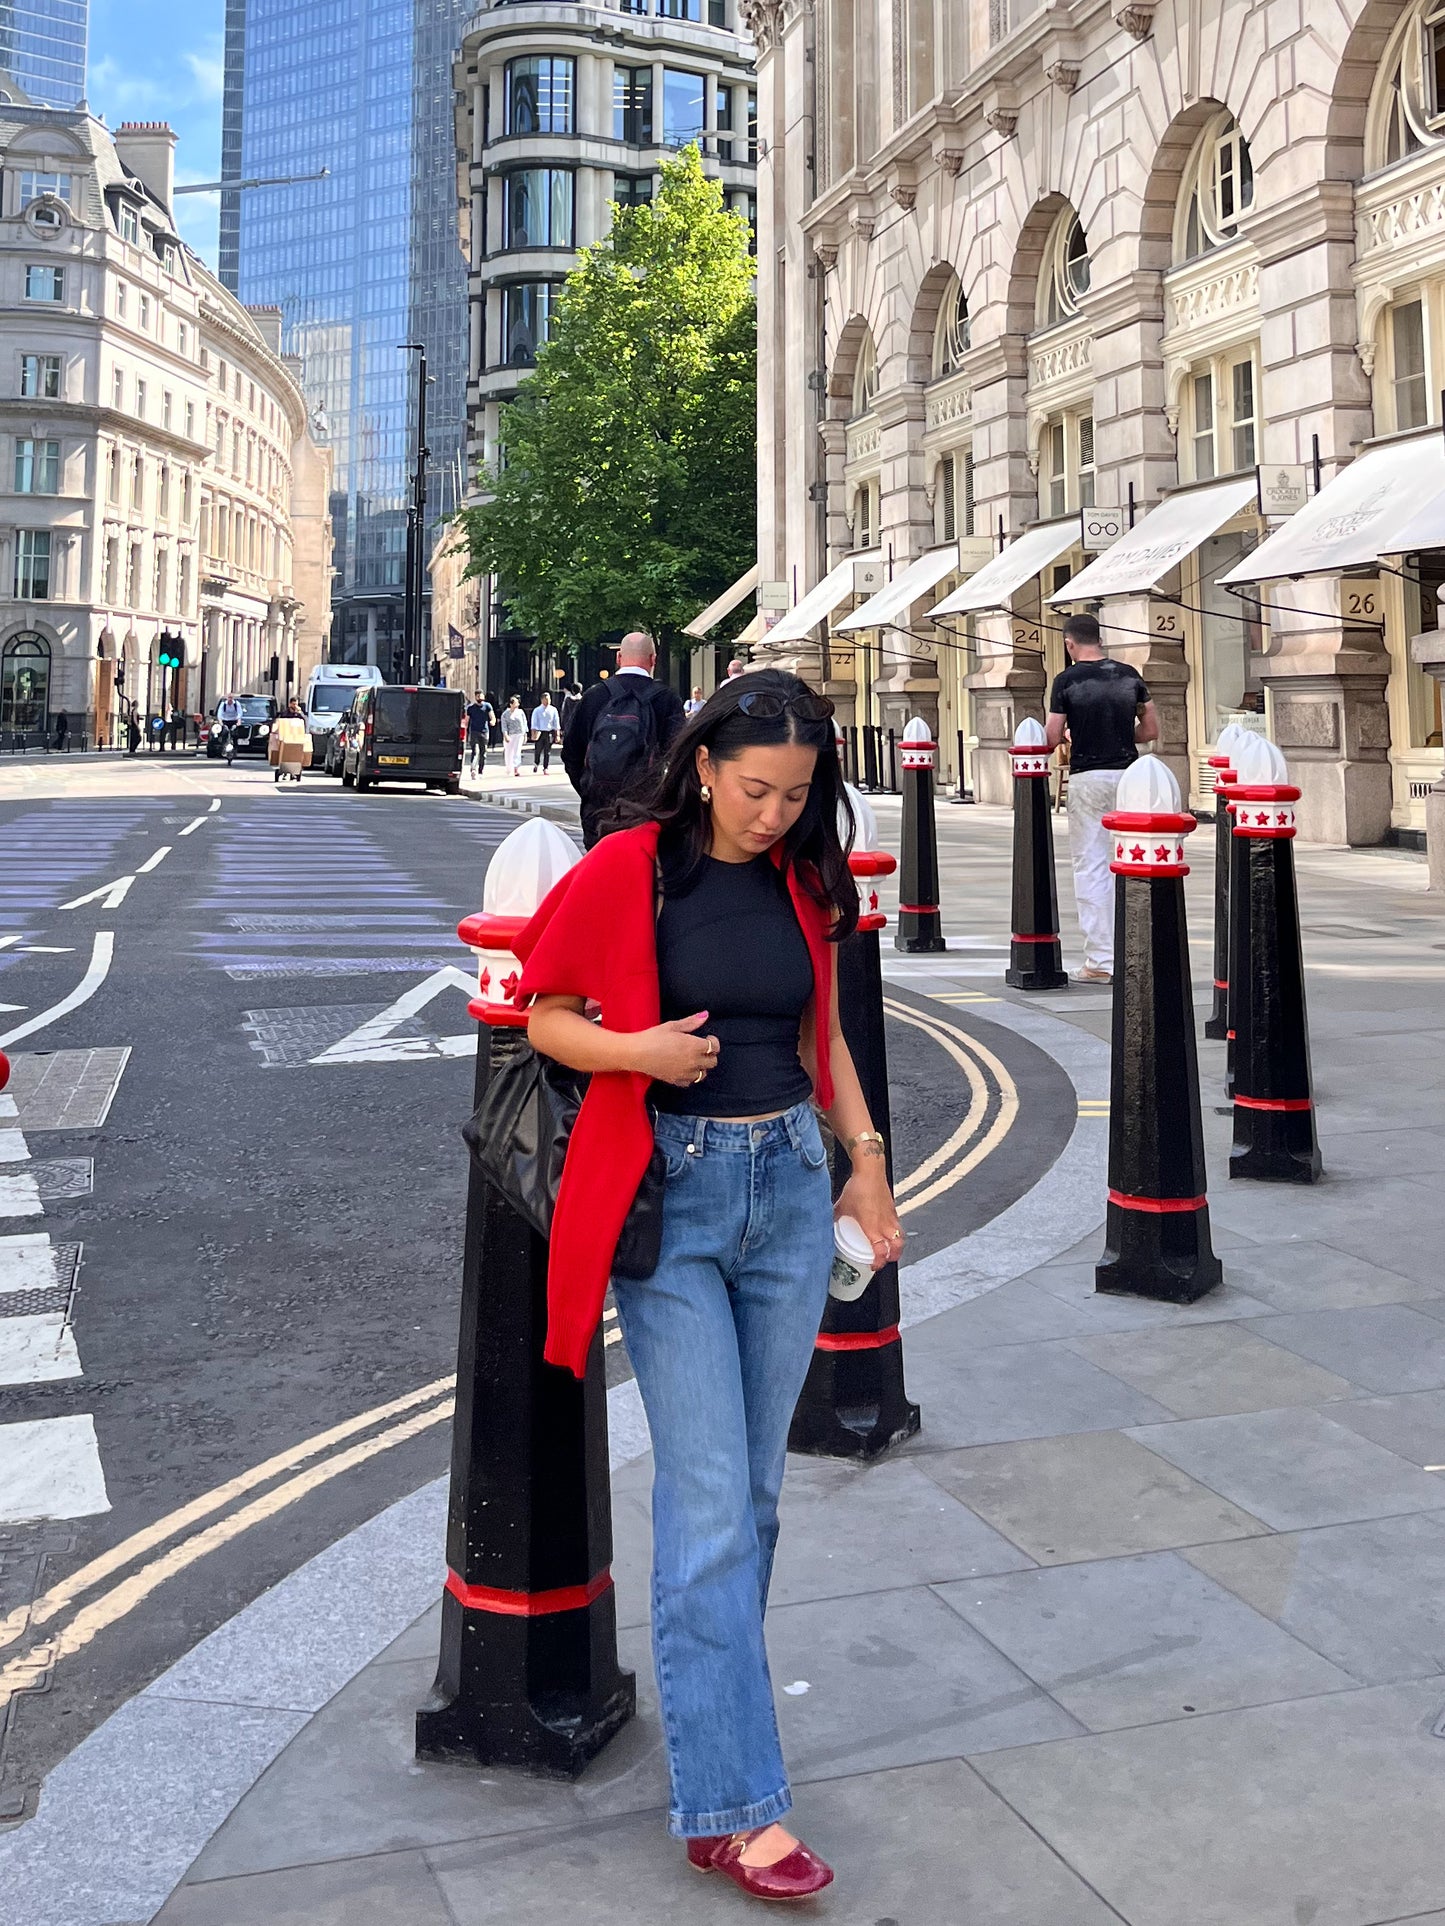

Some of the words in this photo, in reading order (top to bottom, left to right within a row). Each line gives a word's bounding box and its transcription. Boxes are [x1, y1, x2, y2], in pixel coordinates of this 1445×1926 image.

[1265, 487, 1301, 496] CROCKETT
[1349, 593, 1375, 614] 26
[1156, 615, 1175, 631] 25
[1014, 629, 1040, 643] 24
